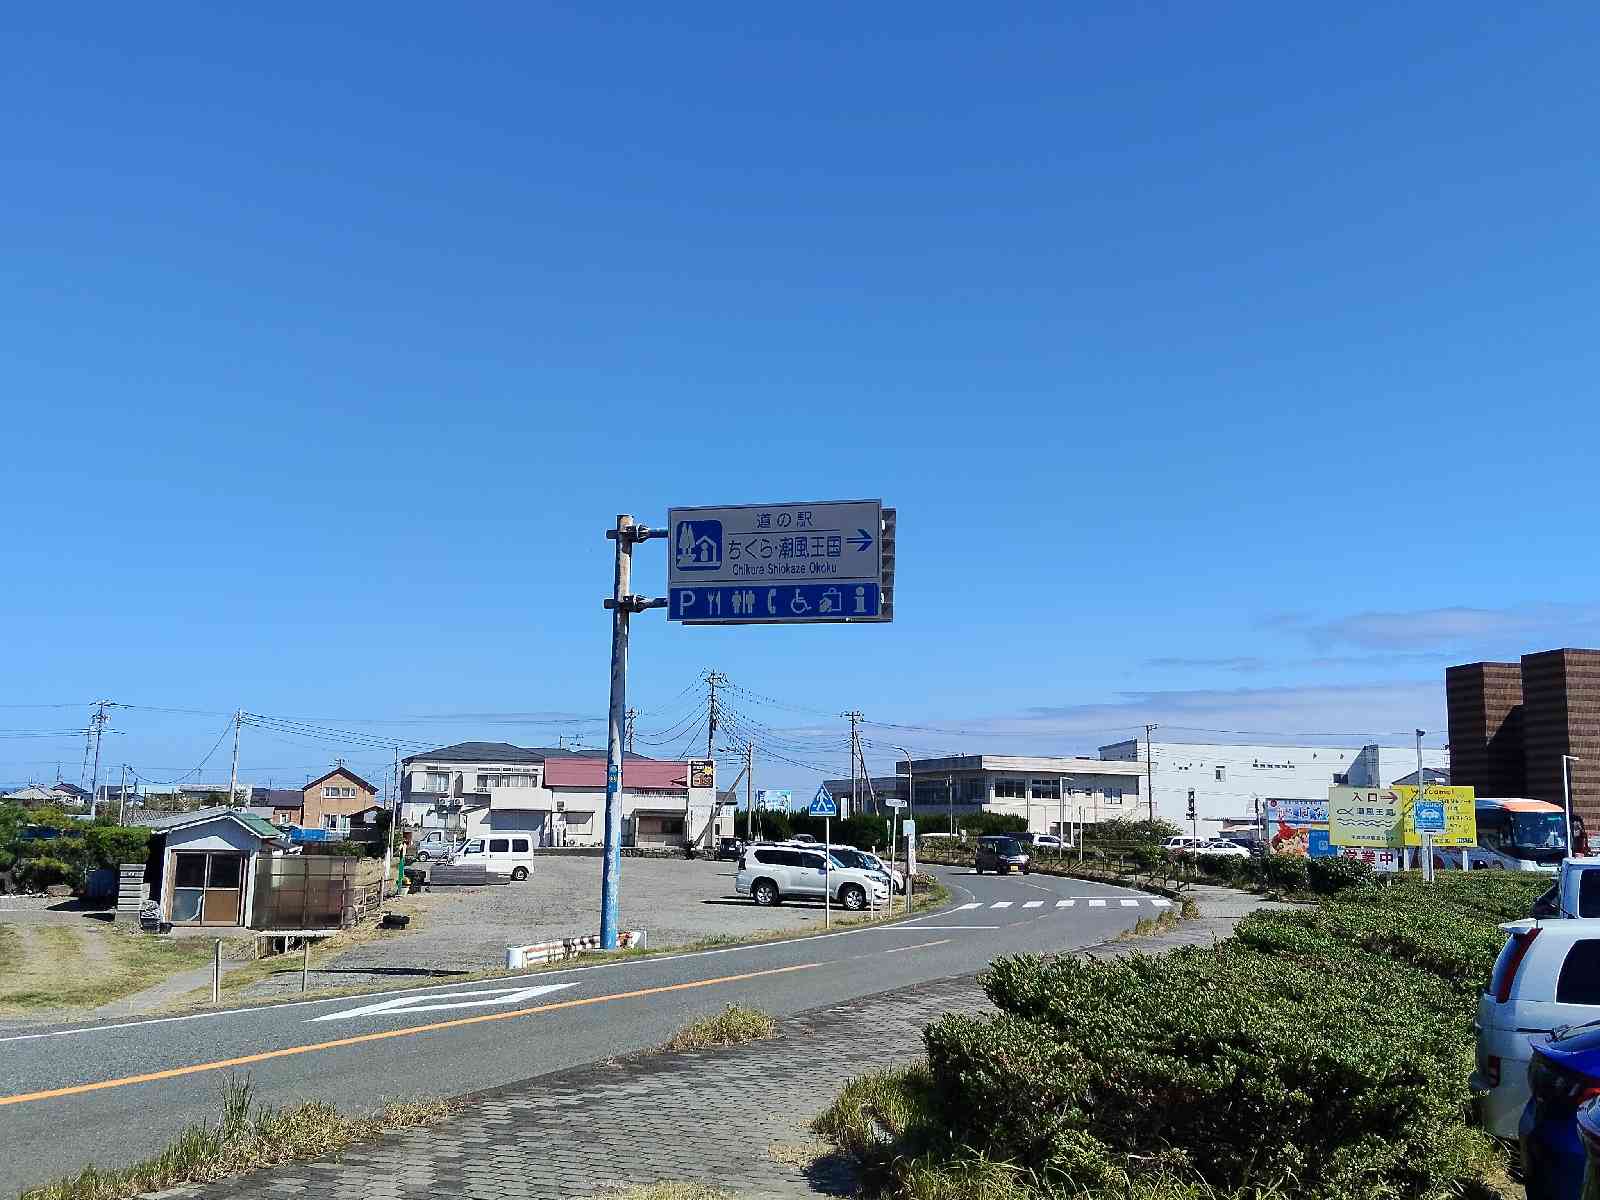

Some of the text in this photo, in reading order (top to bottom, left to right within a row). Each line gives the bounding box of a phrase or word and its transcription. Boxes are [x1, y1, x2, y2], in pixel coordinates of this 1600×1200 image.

[756, 511, 815, 529] 道の駅
[732, 561, 837, 576] Chikura Shiokaze Okoku
[1352, 791, 1378, 803] 入口
